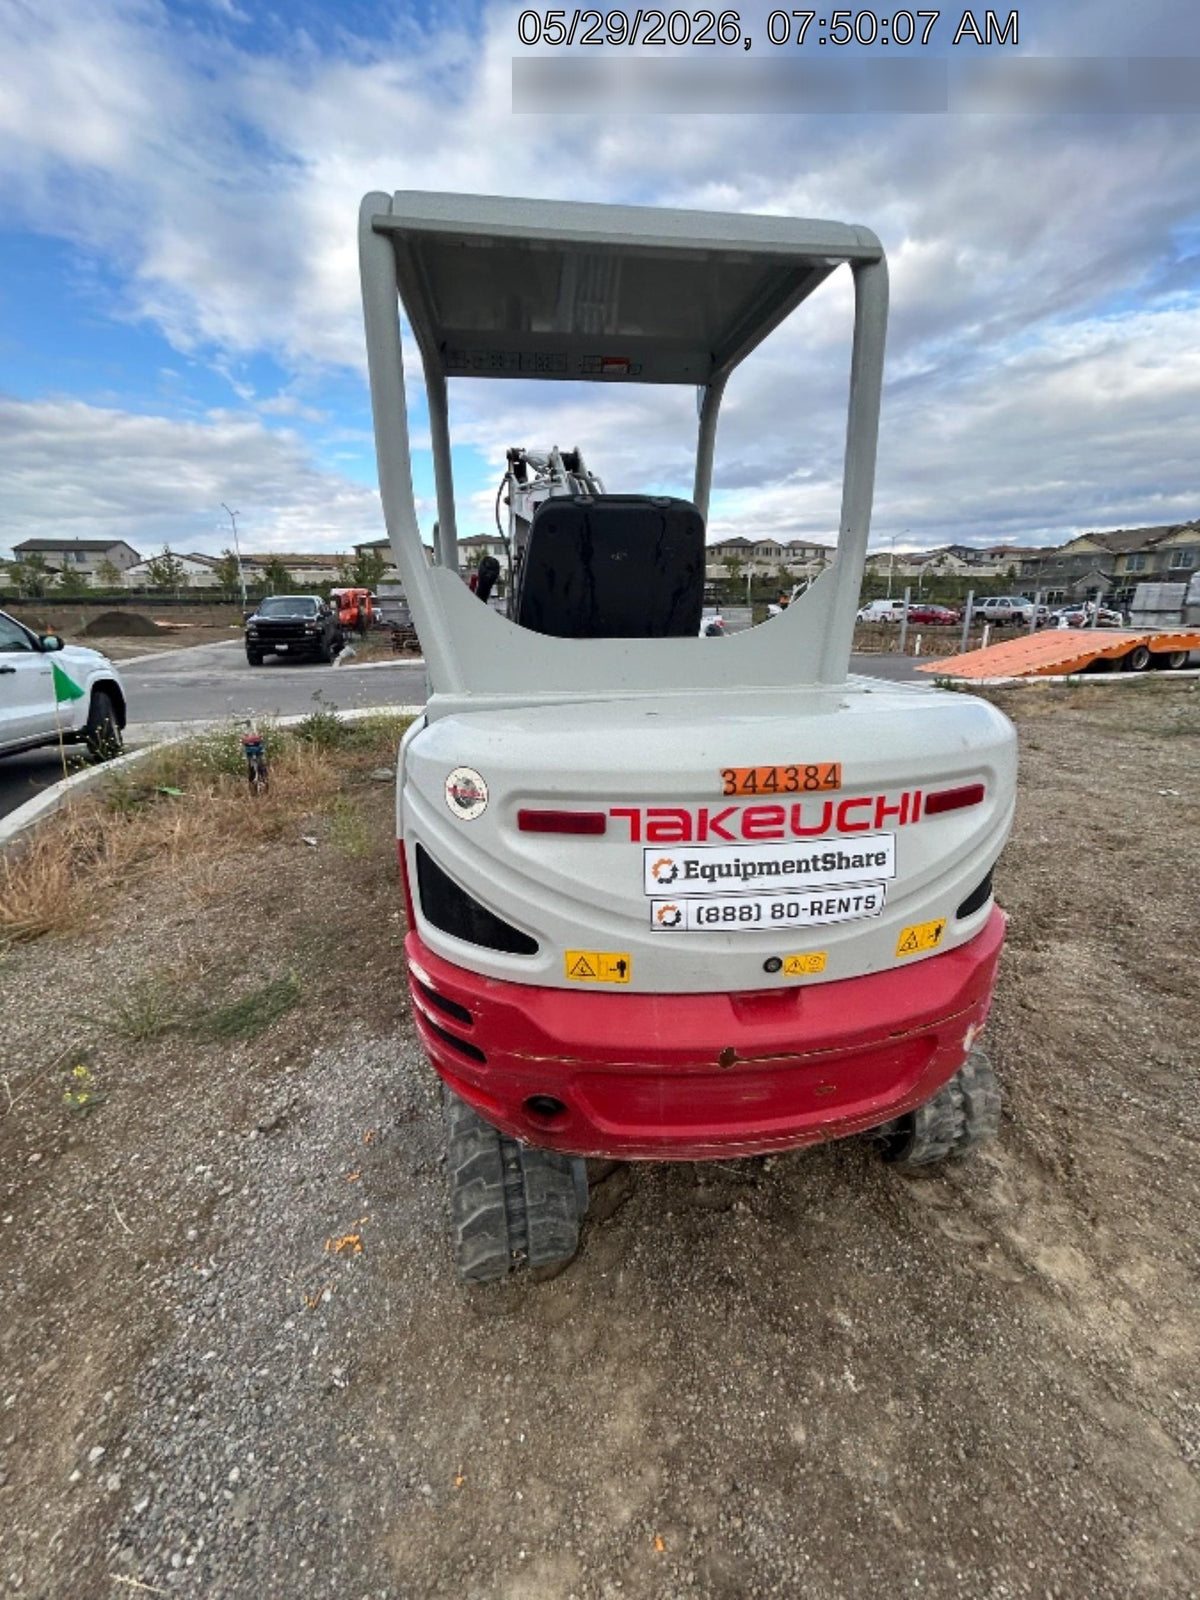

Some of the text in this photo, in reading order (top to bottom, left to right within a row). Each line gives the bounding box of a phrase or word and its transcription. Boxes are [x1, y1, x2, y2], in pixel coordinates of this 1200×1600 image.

[722, 764, 840, 796] 344384
[683, 850, 887, 882] EquipmentShare
[696, 894, 877, 926] (888) 80-RENTS
